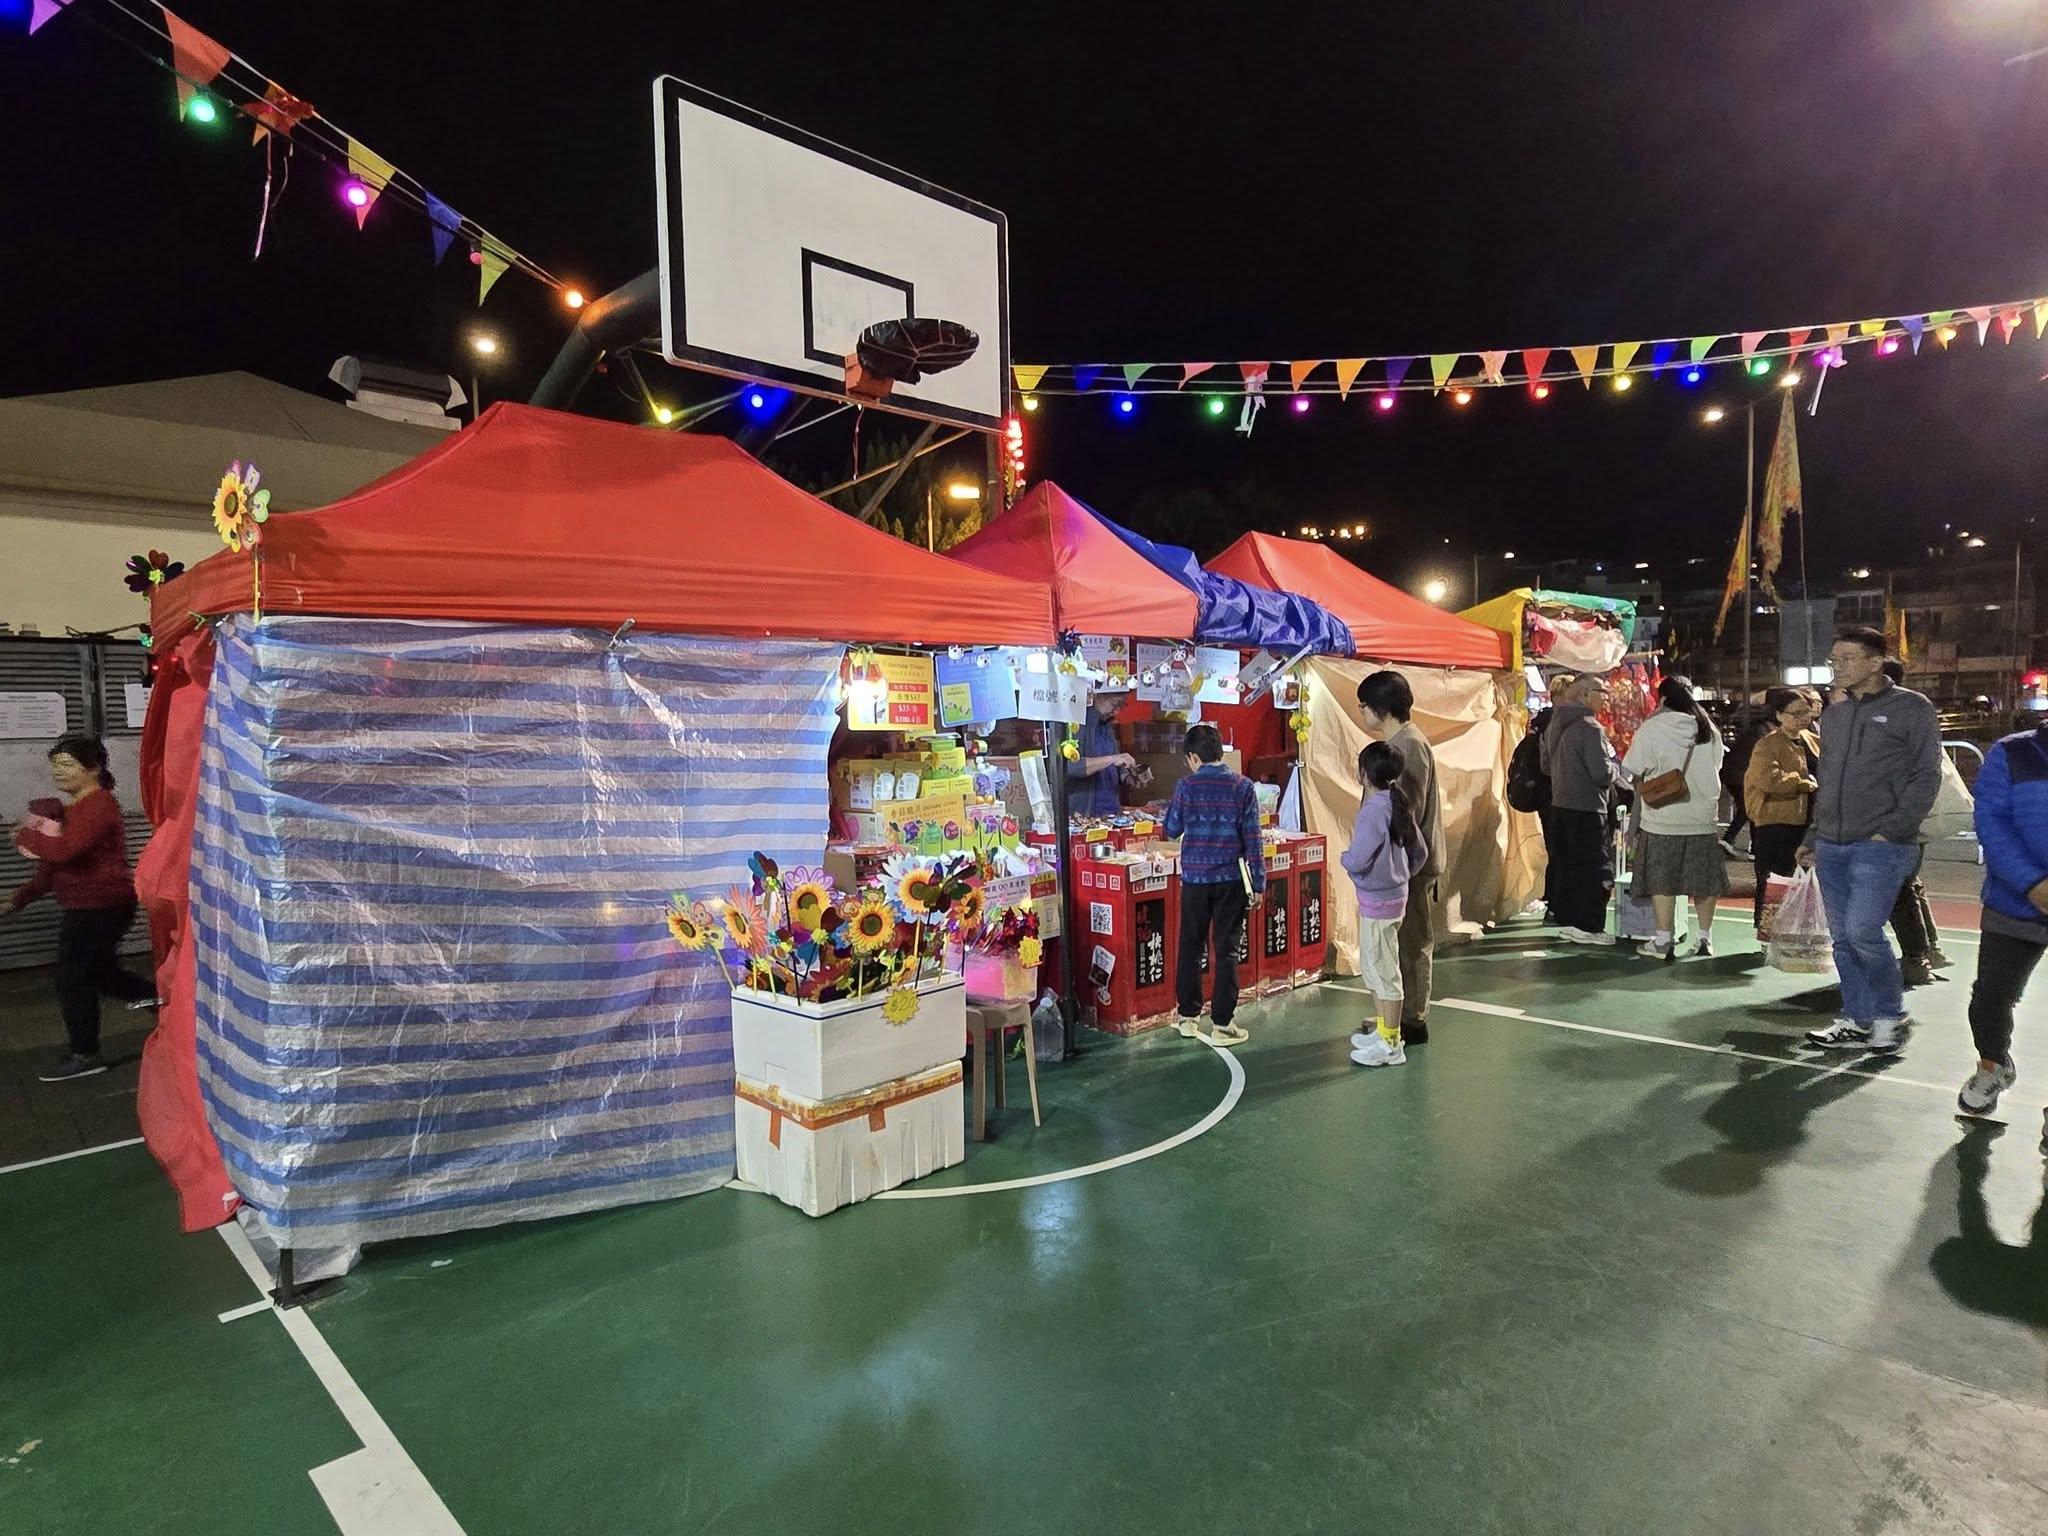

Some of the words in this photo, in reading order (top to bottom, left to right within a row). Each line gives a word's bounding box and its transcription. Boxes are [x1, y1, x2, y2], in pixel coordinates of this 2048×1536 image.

[1274, 907, 1287, 952] 核桃仁
[1309, 898, 1321, 942] 核桃仁
[1147, 932, 1163, 982] 核桃仁
[891, 996, 915, 1012] $20
